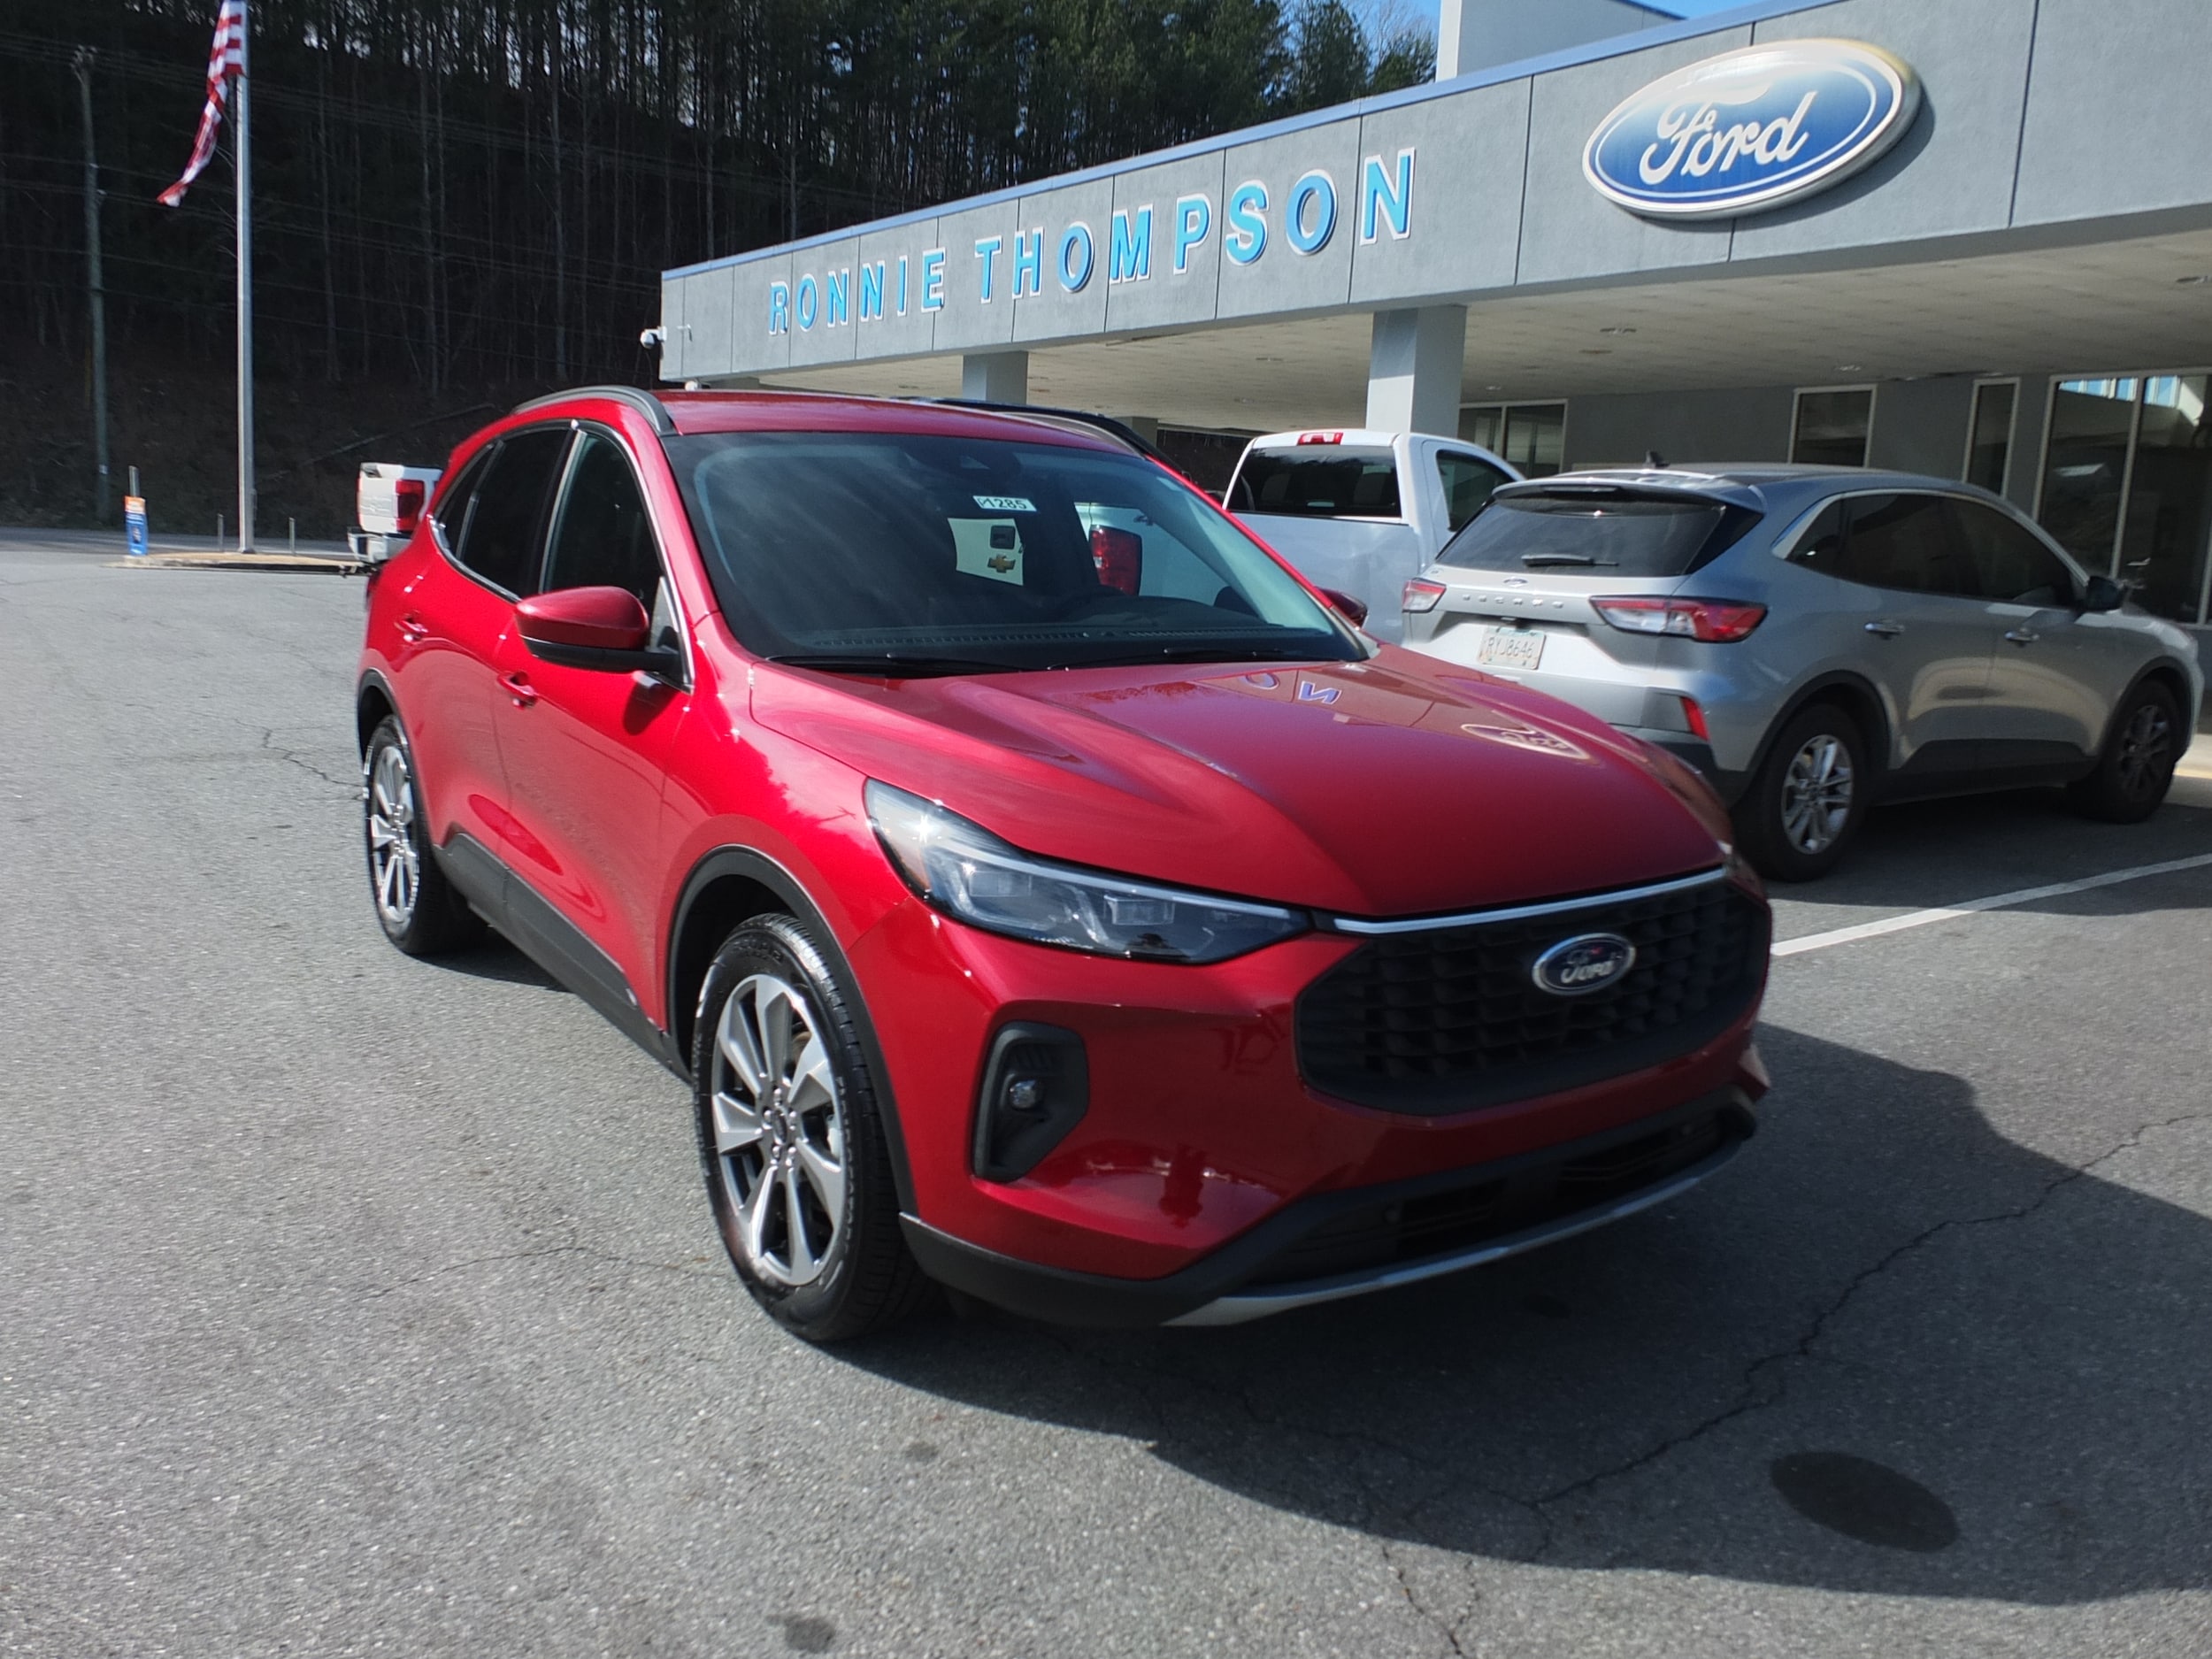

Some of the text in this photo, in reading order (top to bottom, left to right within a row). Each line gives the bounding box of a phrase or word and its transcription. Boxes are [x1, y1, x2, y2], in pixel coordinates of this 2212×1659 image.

[1639, 76, 1818, 185] Ford
[768, 147, 1416, 335] RONNIE THOMPSON
